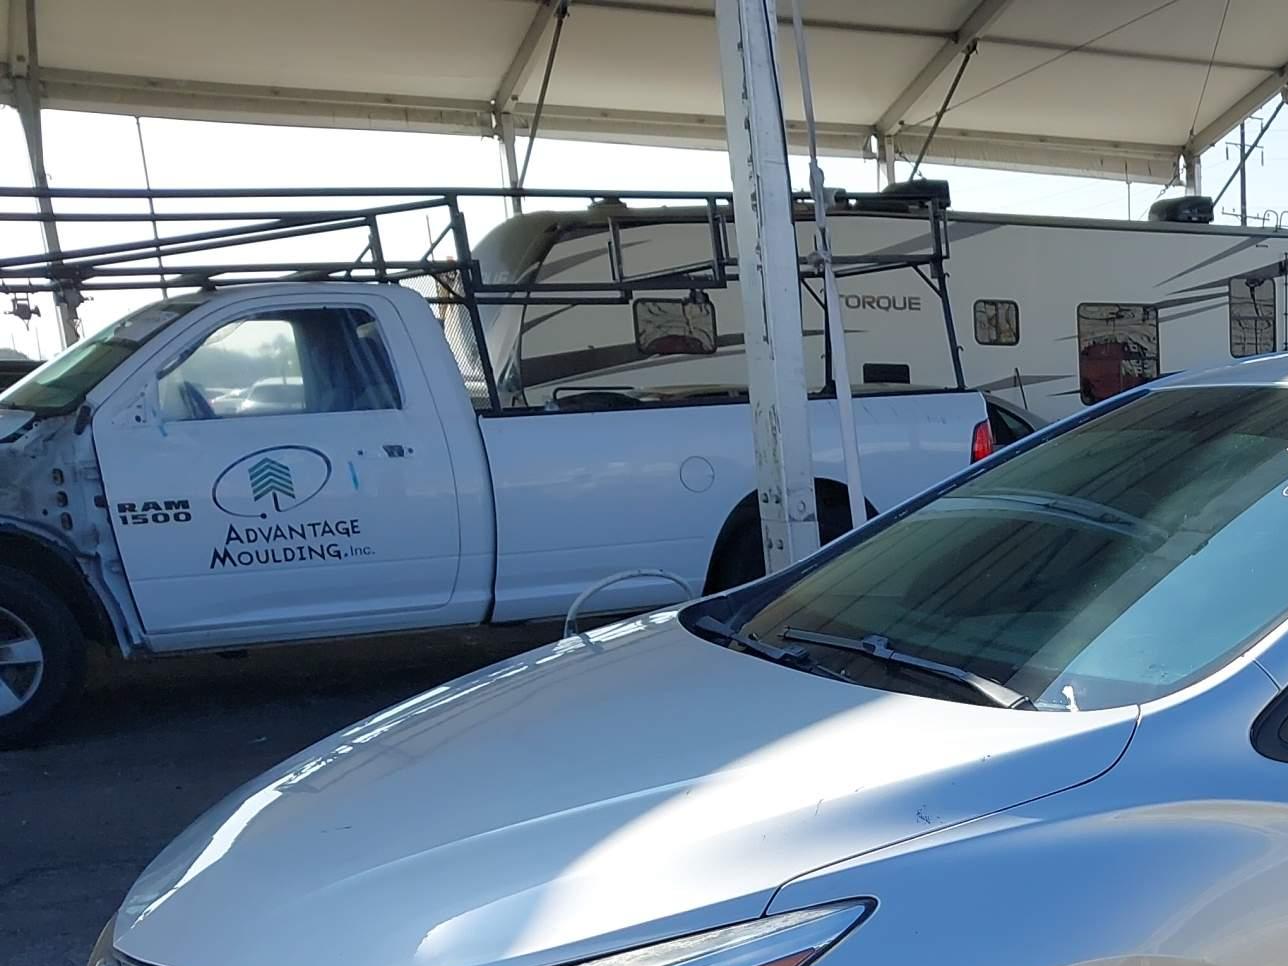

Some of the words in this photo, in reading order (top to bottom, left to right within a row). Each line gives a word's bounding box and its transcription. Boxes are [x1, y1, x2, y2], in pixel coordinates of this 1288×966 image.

[839, 294, 921, 312] ORQUE
[117, 500, 190, 513] RAM
[119, 511, 192, 525] 1500
[225, 519, 361, 545] ADVANTAGE
